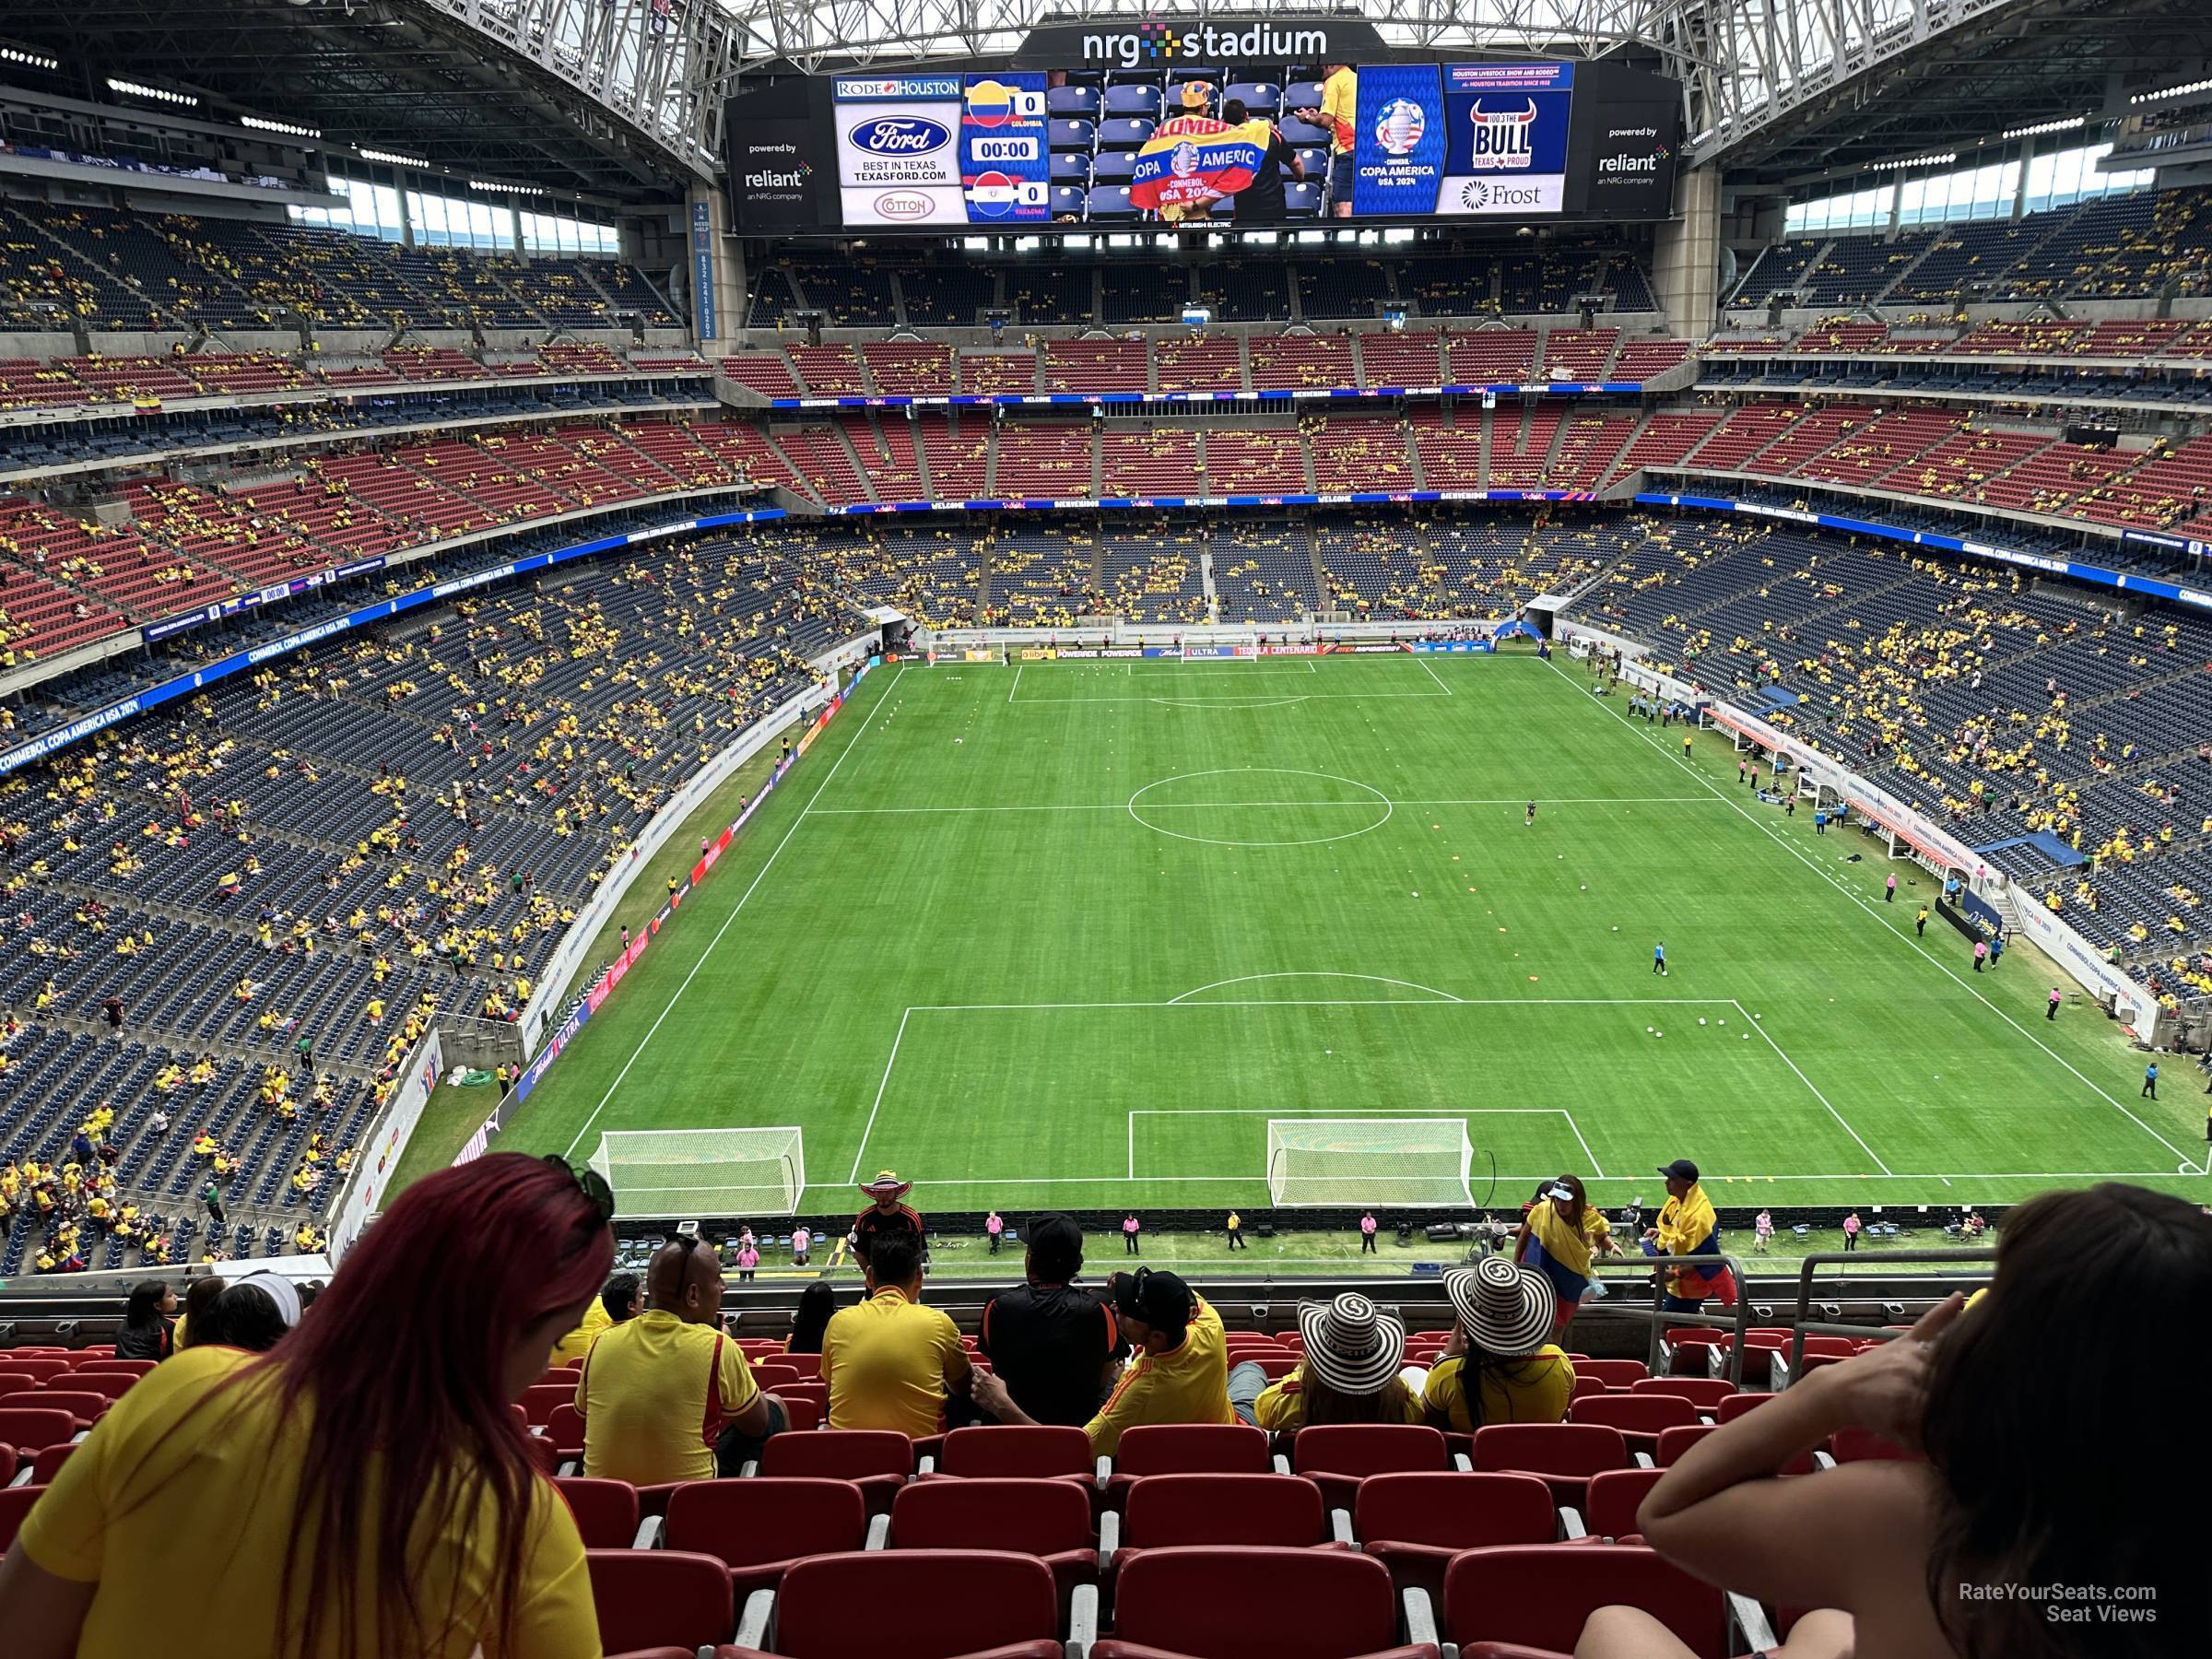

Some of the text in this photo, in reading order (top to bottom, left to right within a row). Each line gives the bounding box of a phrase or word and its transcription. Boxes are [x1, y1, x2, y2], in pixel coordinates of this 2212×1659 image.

[1083, 23, 1327, 68] nrg stadium
[899, 81, 959, 95] HOUSTON
[1025, 96, 1036, 112] 0
[1506, 114, 1517, 123] THE
[869, 121, 931, 152] Ford
[1608, 126, 1657, 138] powered by
[1475, 124, 1530, 155] BULL
[748, 144, 796, 155] powered by
[981, 142, 1030, 159] 00:00
[863, 160, 936, 171] BEST IN TEXAS
[1474, 156, 1530, 166] TEXAS PROUD
[1598, 154, 1656, 171] reliant
[853, 171, 947, 182] TEXASFORD.COM
[1134, 160, 1161, 181] OPA
[1359, 166, 1435, 177] COPA AMERICA
[745, 170, 803, 187] reliant
[1377, 177, 1417, 186] USA 2024
[1623, 177, 1654, 185] company
[756, 193, 772, 201] NRG
[772, 193, 803, 202] company
[1028, 186, 1038, 202] 0
[1185, 187, 1210, 199] 202
[1491, 185, 1542, 205] Frost
[248, 641, 284, 663] CONMEBOL
[283, 636, 300, 650] COPA
[300, 626, 326, 643] AMERICA
[1238, 645, 1318, 655] TEQUILA CENTENARIO
[1056, 650, 1098, 658] POWERADE
[1100, 649, 1143, 658] POWERADE
[1191, 648, 1219, 656] ULTRA
[0, 700, 138, 771] CONMEBOL COPA AMERICA USA 2024
[2066, 942, 2142, 1011] CONMEBOL COPA AMERICA USA 2024
[557, 1016, 581, 1049] ULTRA
